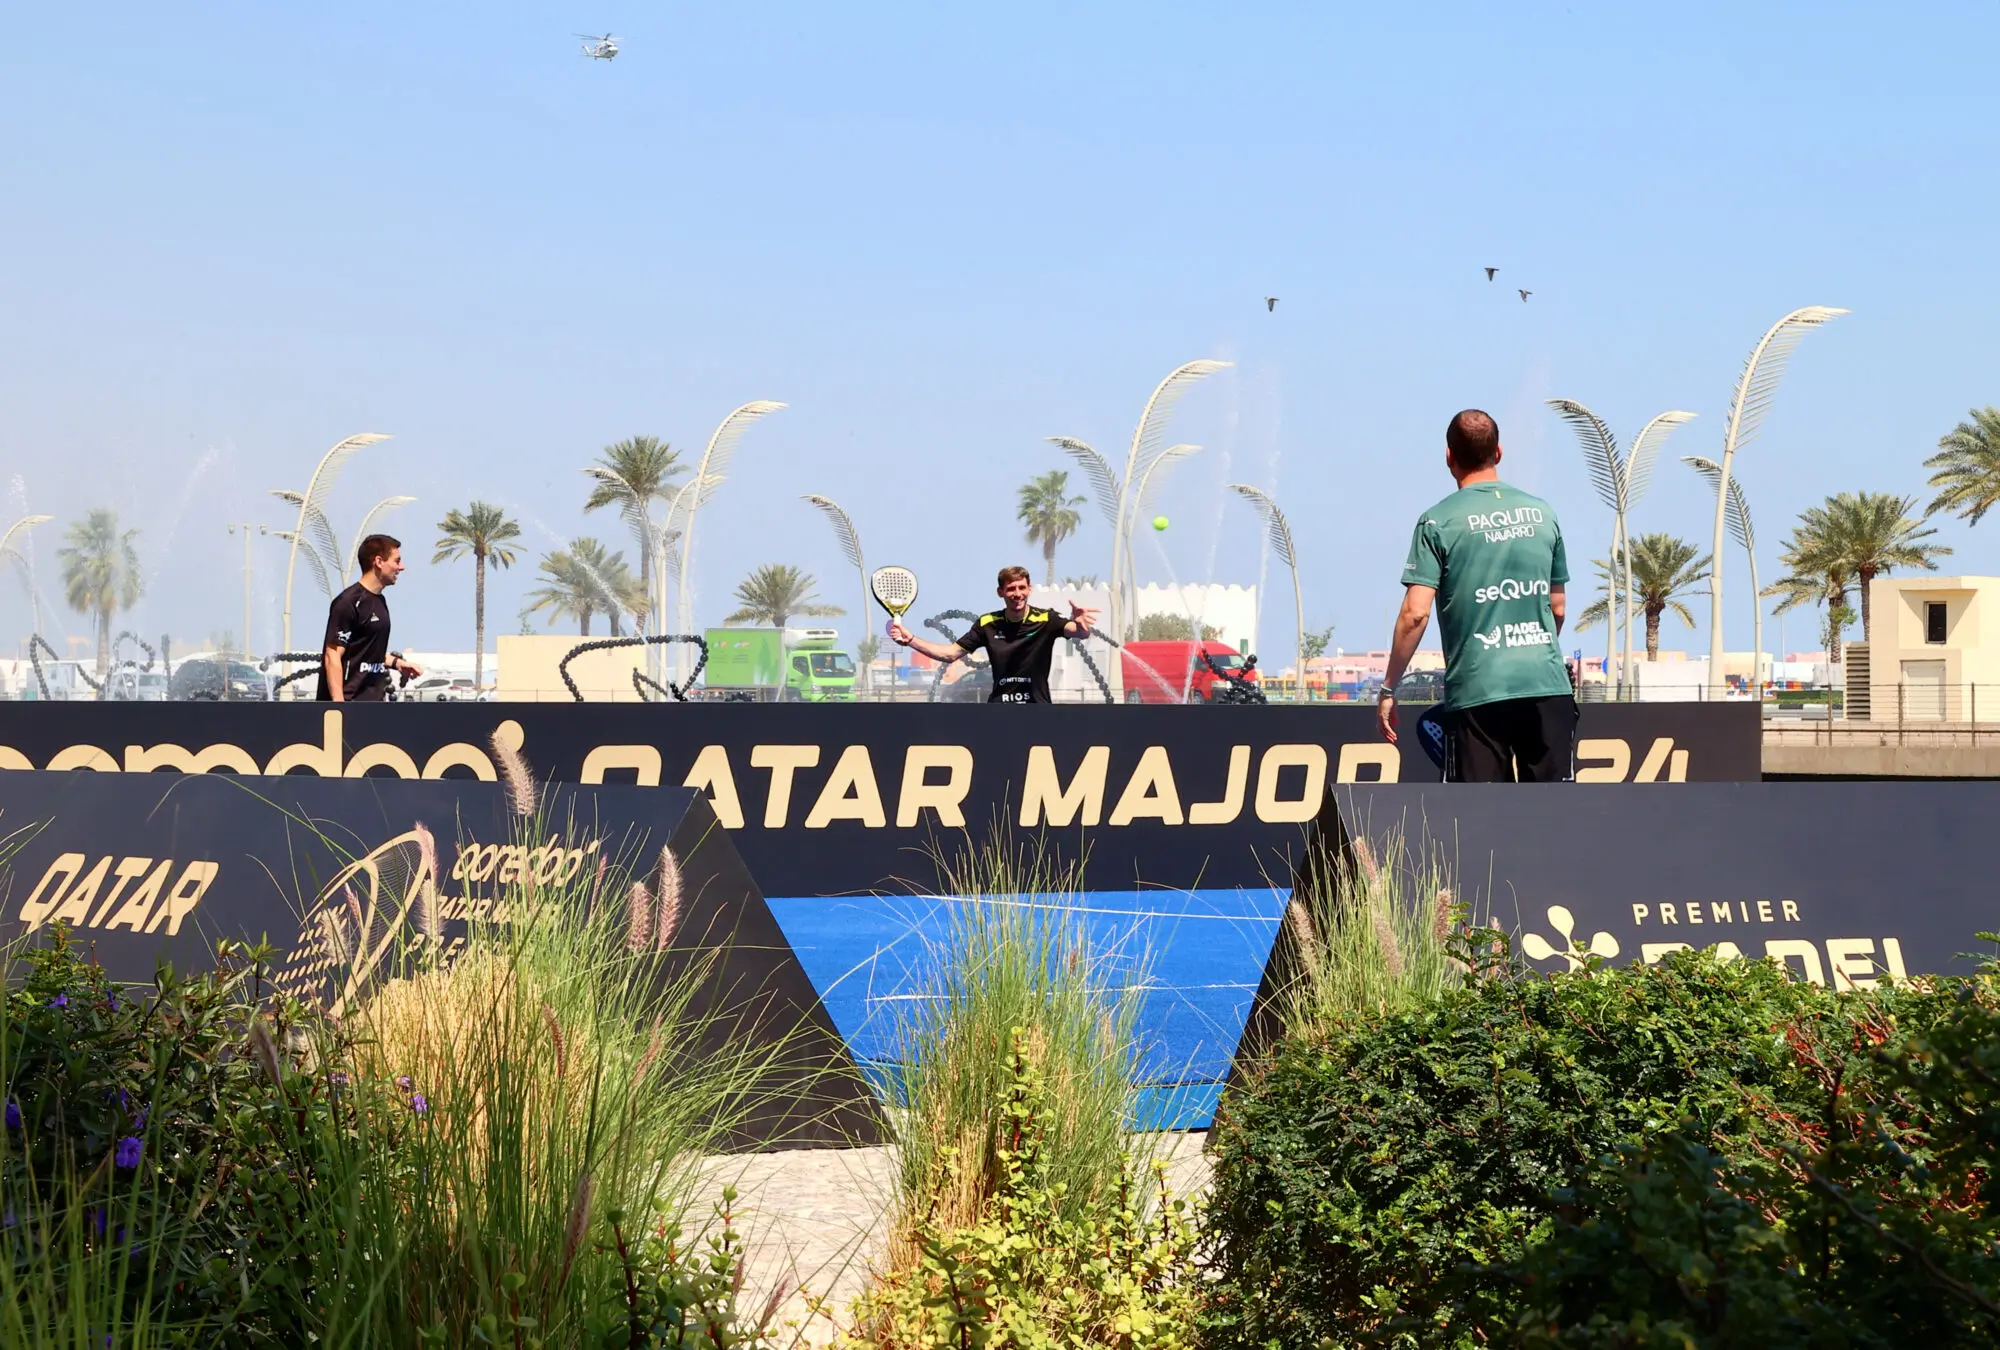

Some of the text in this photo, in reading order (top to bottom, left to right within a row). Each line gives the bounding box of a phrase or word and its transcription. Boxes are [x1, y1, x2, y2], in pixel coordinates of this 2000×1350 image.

[1467, 507, 1543, 531] PAQUITO
[1484, 526, 1535, 544] NAVARRO
[1504, 621, 1544, 636] PADEL
[1002, 692, 1031, 703] RIOS
[1510, 737, 1689, 783] 24
[19, 852, 220, 937] QATAR
[433, 895, 493, 923] ATAR
[1632, 900, 1801, 926] PREMIER
[1641, 937, 1936, 994] DEL
